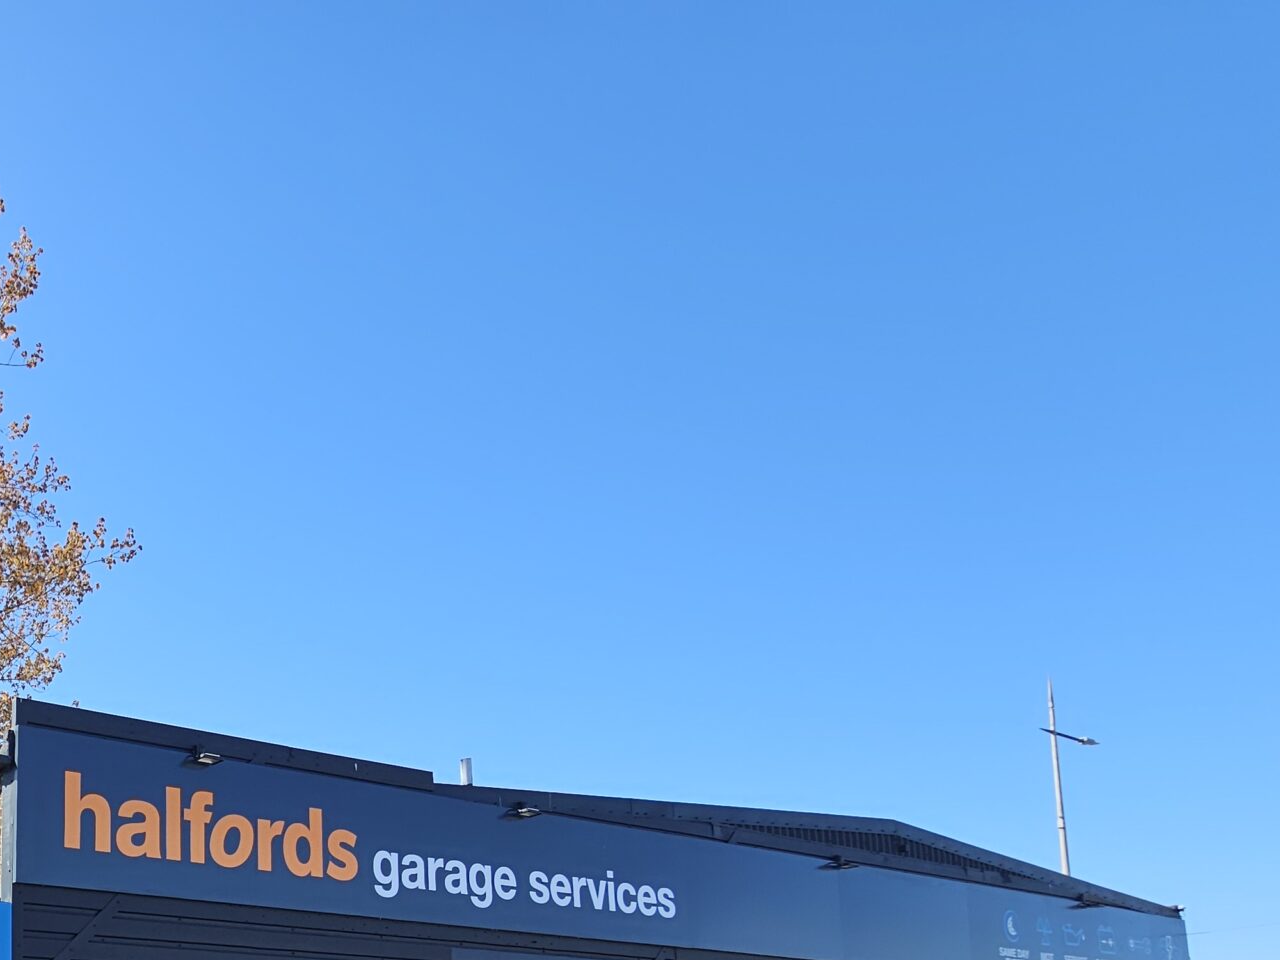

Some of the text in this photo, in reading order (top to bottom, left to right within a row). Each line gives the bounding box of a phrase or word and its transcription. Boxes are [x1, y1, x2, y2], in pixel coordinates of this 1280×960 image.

[64, 770, 676, 919] halfords garage services
